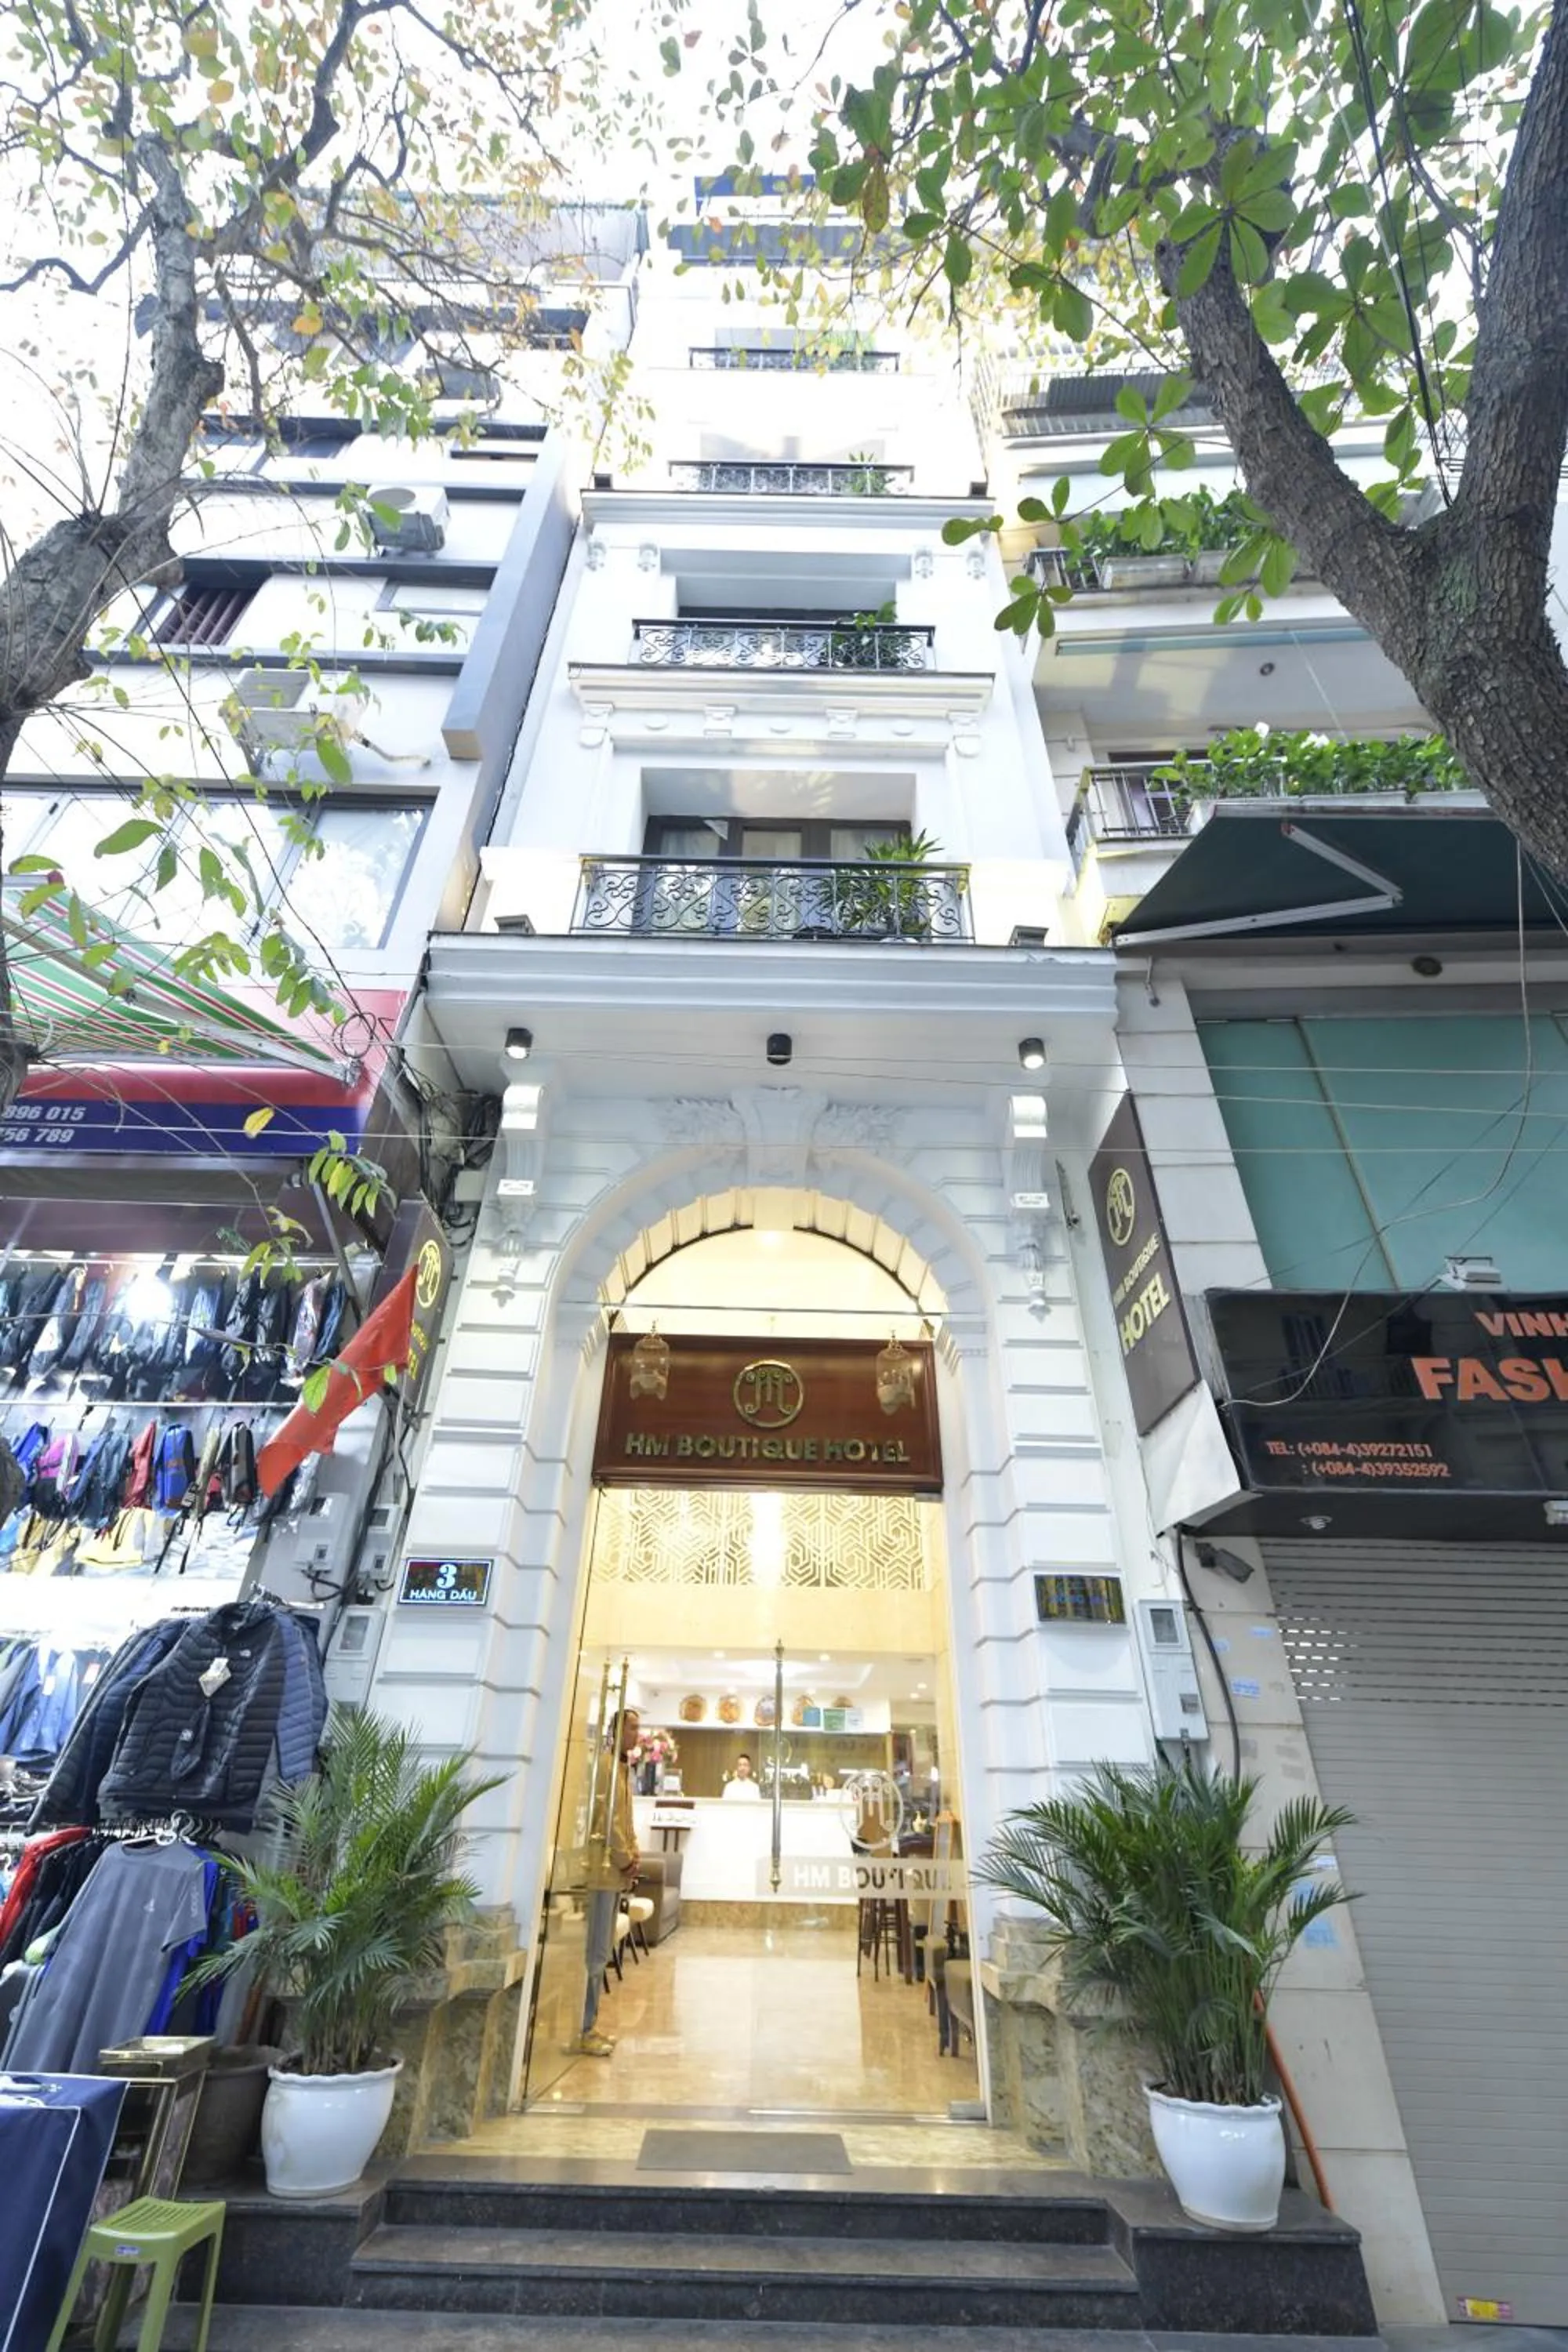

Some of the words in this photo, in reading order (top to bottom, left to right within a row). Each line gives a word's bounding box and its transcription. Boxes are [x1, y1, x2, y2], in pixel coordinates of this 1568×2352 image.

[45, 1105, 87, 1121] 015
[34, 1128, 75, 1143] 789
[1118, 1272, 1171, 1356] HOTEL
[626, 1432, 670, 1456] HM
[677, 1434, 818, 1461] BOUTIQUE
[824, 1438, 911, 1463] HOTEL
[1265, 1441, 1295, 1455] TEL:
[436, 1564, 457, 1589] 3
[793, 1864, 831, 1889] HM
